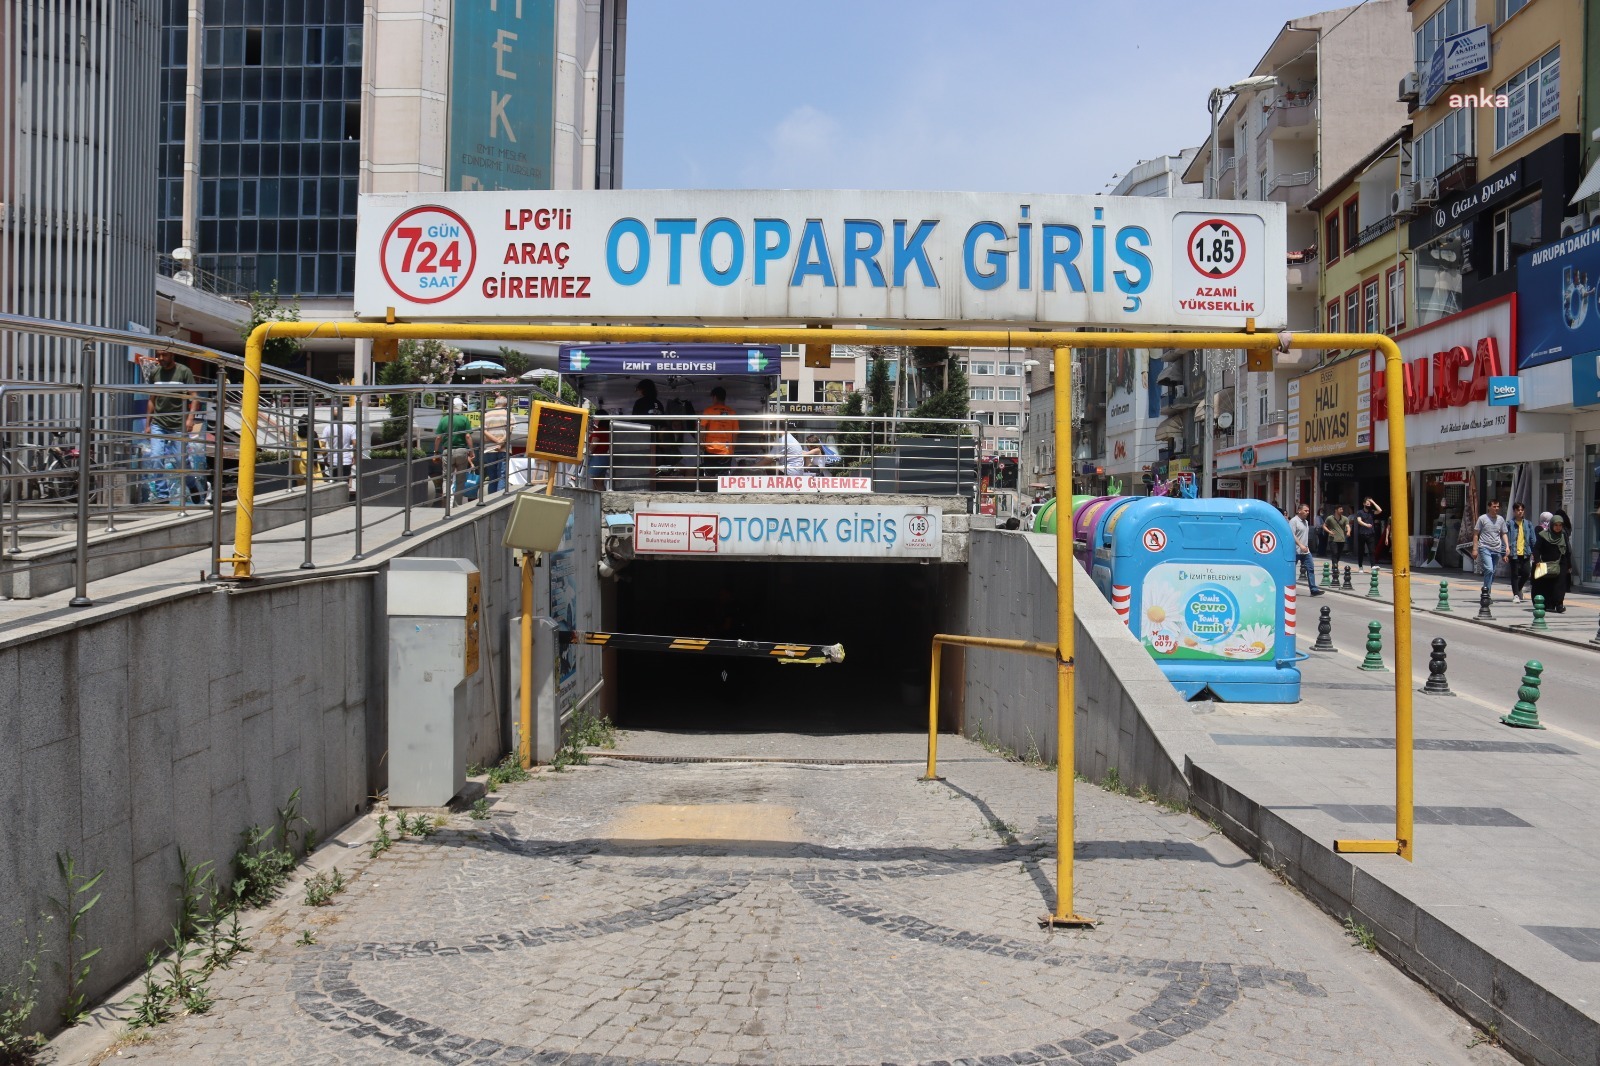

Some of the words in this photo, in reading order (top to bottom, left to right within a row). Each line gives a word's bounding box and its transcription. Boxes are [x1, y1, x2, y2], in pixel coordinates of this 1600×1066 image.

[489, 0, 523, 143] EK
[427, 223, 460, 239] GÜN
[1195, 237, 1235, 263] 1.85
[1531, 229, 1591, 267] AVRUPA'DAKİ
[503, 242, 570, 270] ARAÇ
[605, 217, 940, 288] OTOPARK
[963, 204, 1153, 313] GİRİŞ
[419, 275, 458, 289] SAAT
[482, 272, 592, 299] GİREMEZ
[1195, 285, 1237, 297] AZAMİ
[1179, 298, 1255, 312] YÜKSEKLİK
[661, 350, 680, 359] T.C.
[622, 360, 652, 371] İZMİT
[656, 360, 717, 371] BELEDİYESİ
[1315, 382, 1339, 412] HALI
[1493, 385, 1516, 394] beko
[1304, 411, 1350, 444] DÜNYASI
[1323, 463, 1354, 472] EVSER
[766, 476, 803, 491] ARAÇ
[719, 517, 829, 543] OTOPARK
[836, 513, 898, 550] GİRİŞ
[1191, 603, 1227, 615] Çevre
[1193, 623, 1225, 634] İzmit
[1157, 634, 1170, 642] 318
